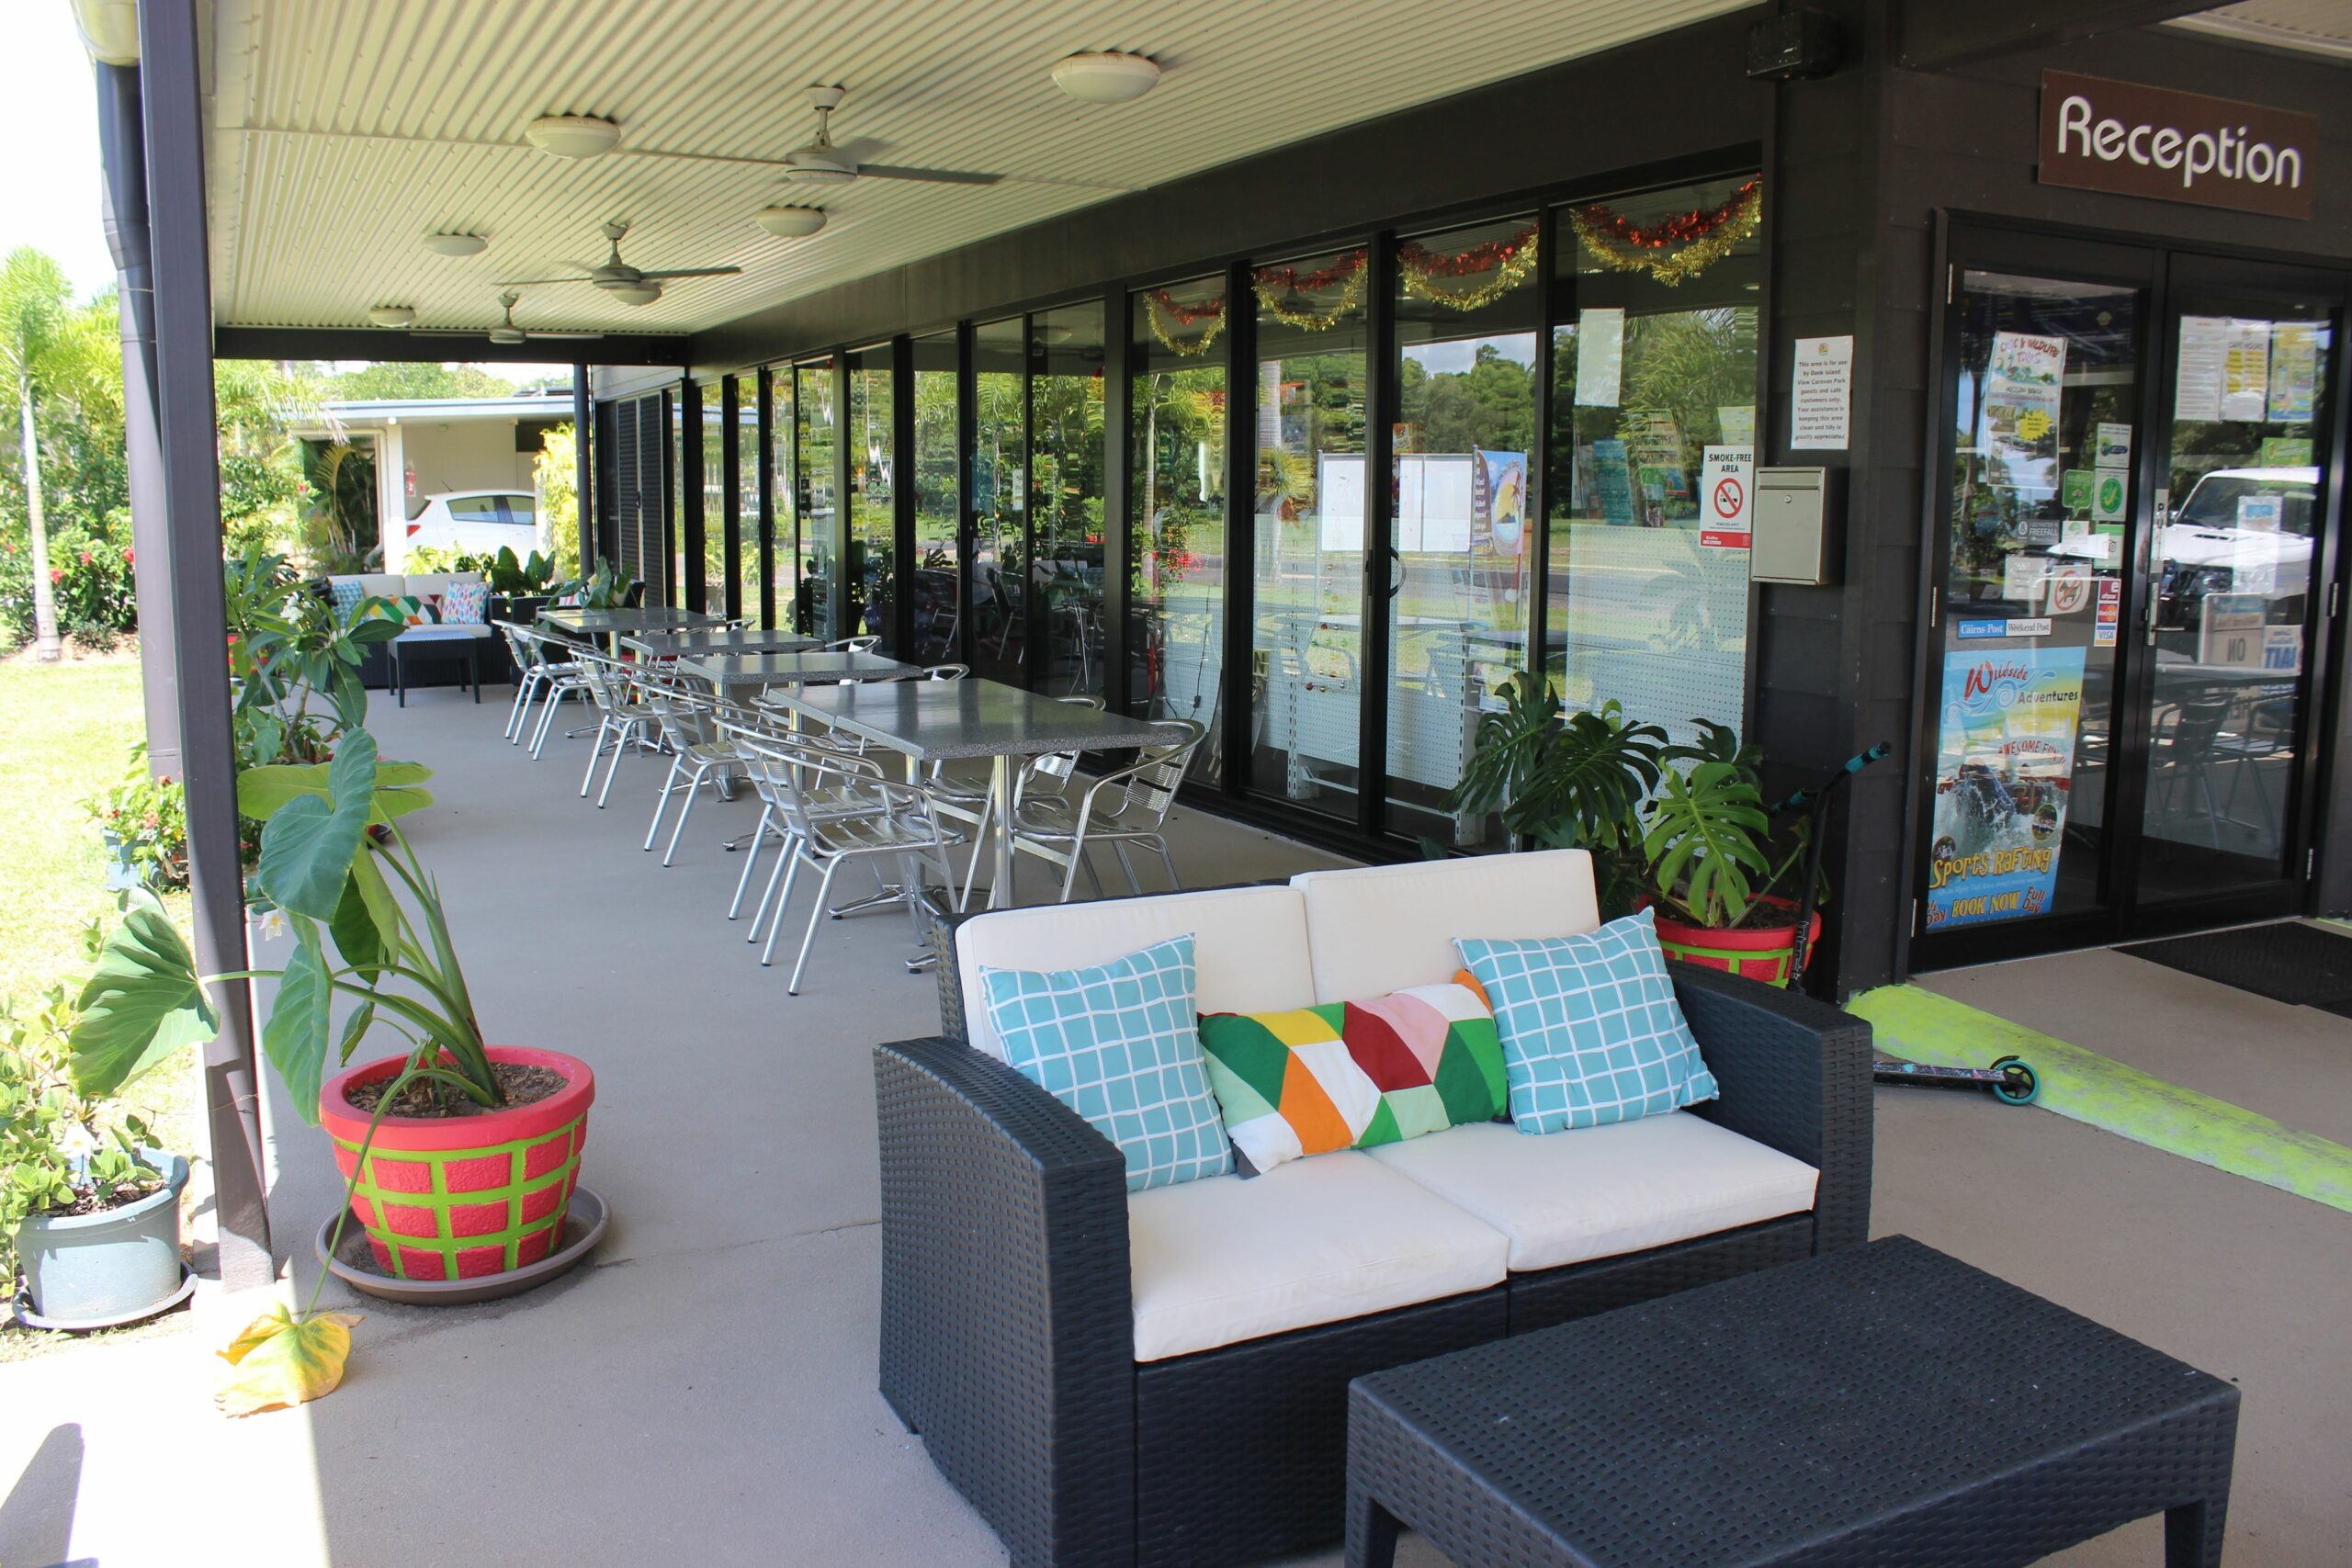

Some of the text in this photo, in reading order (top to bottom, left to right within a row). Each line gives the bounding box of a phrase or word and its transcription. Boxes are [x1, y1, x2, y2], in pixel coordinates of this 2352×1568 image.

[2057, 96, 2301, 188] Reception
[1708, 453, 1753, 462] SMOKE-FREE
[1720, 465, 1739, 473] AREA
[2029, 527, 2058, 536] FREEFALL
[1961, 623, 2004, 635] Cairns Post
[2007, 621, 2050, 633] Weekend Post
[2098, 630, 2114, 639] VISA
[1963, 660, 2030, 701] Wildside
[2018, 690, 2079, 705] Adventures
[1951, 895, 1988, 919] BOOK
[1989, 889, 2021, 914] NOW
[2027, 886, 2046, 902] Full
[2022, 897, 2042, 914] Day
